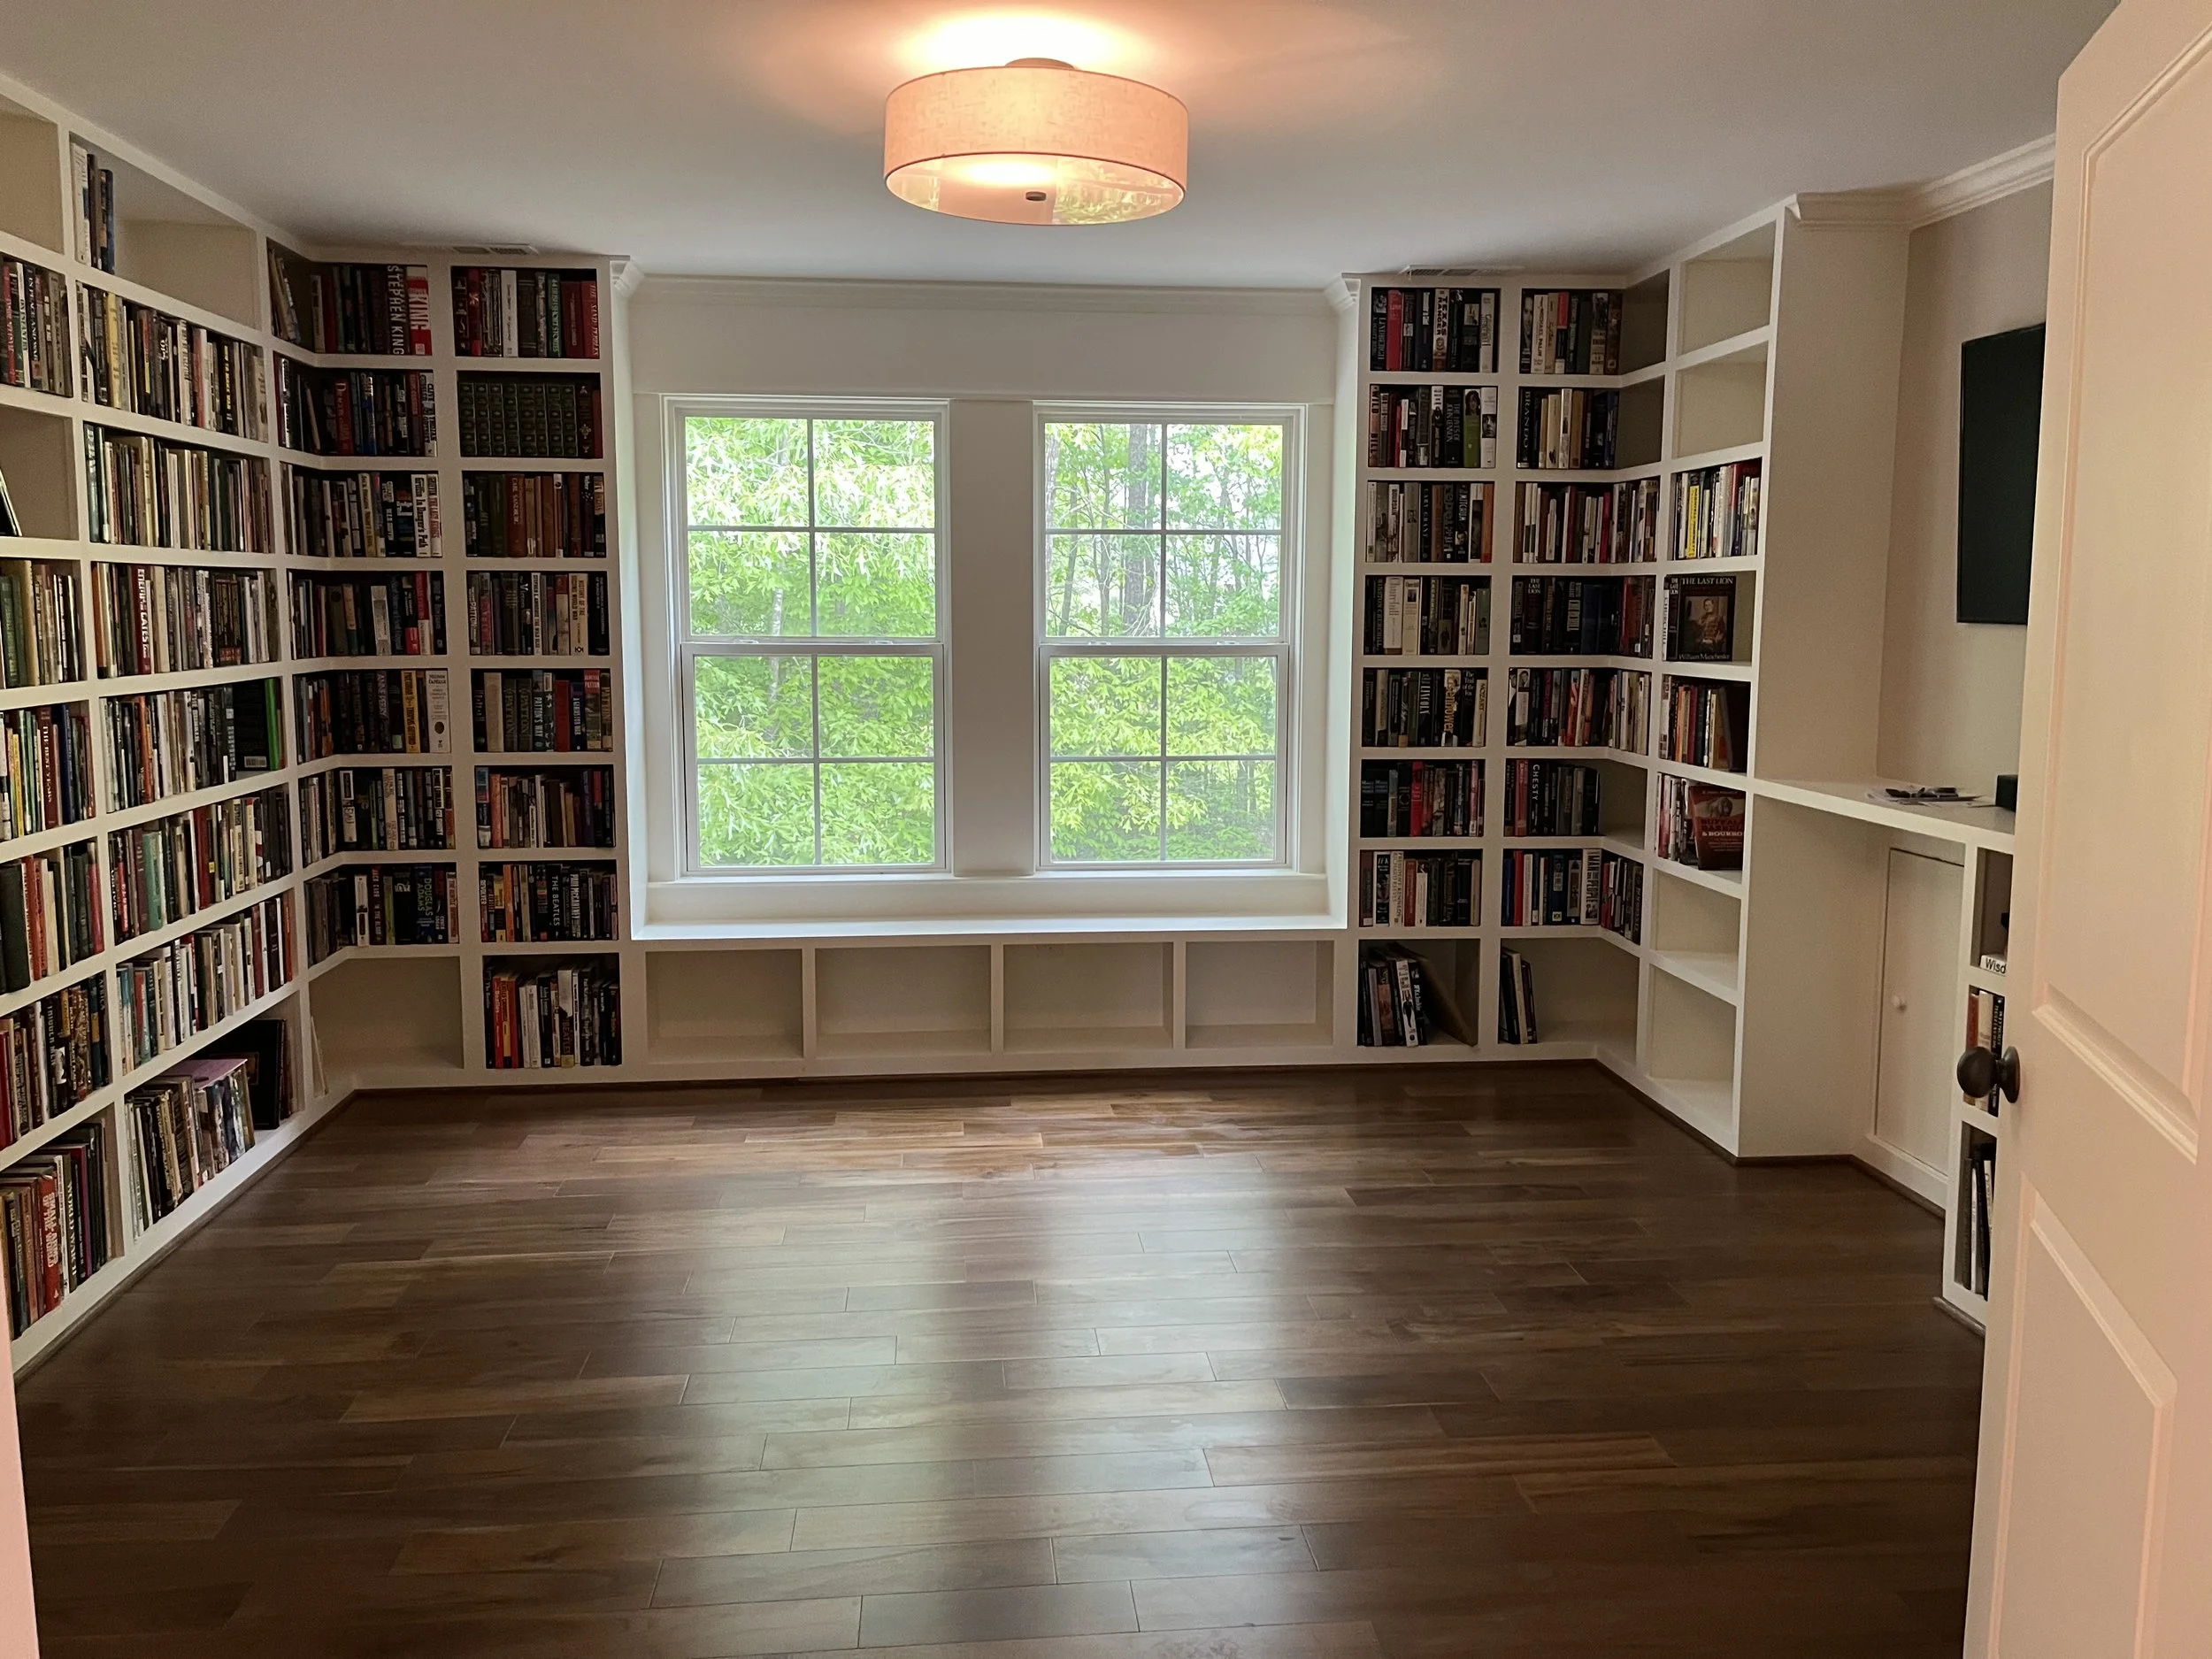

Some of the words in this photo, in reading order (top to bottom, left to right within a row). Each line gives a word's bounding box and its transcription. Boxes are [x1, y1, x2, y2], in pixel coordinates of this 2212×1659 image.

[28, 278, 33, 287] IN
[387, 265, 404, 322] STEPHEN
[409, 294, 428, 330] KING
[391, 326, 404, 355] KING
[1523, 390, 1532, 449] BRANDO
[415, 507, 426, 533] Danger's
[1457, 494, 1468, 521] MITCHUM
[418, 534, 428, 548] Path
[137, 569, 146, 602] ENEMY
[1388, 578, 1401, 616] Churchill
[378, 695, 387, 717] PERRY
[505, 695, 514, 734] PATTON
[602, 687, 611, 719] PATTON
[1419, 686, 1431, 715] LINCOLN
[1444, 676, 1458, 733] Eisenhower
[534, 726, 543, 737] WAY
[1587, 855, 1600, 872] MAN
[570, 874, 580, 887] PAUL
[1586, 879, 1599, 903] PEOPLE
[417, 883, 426, 911] ADAMS
[424, 878, 433, 917] DOUGLAS
[571, 887, 580, 919] McCARTNEY
[562, 1023, 571, 1054] BEATLES
[45, 1233, 54, 1267] WORLD
[71, 1264, 77, 1276] II
